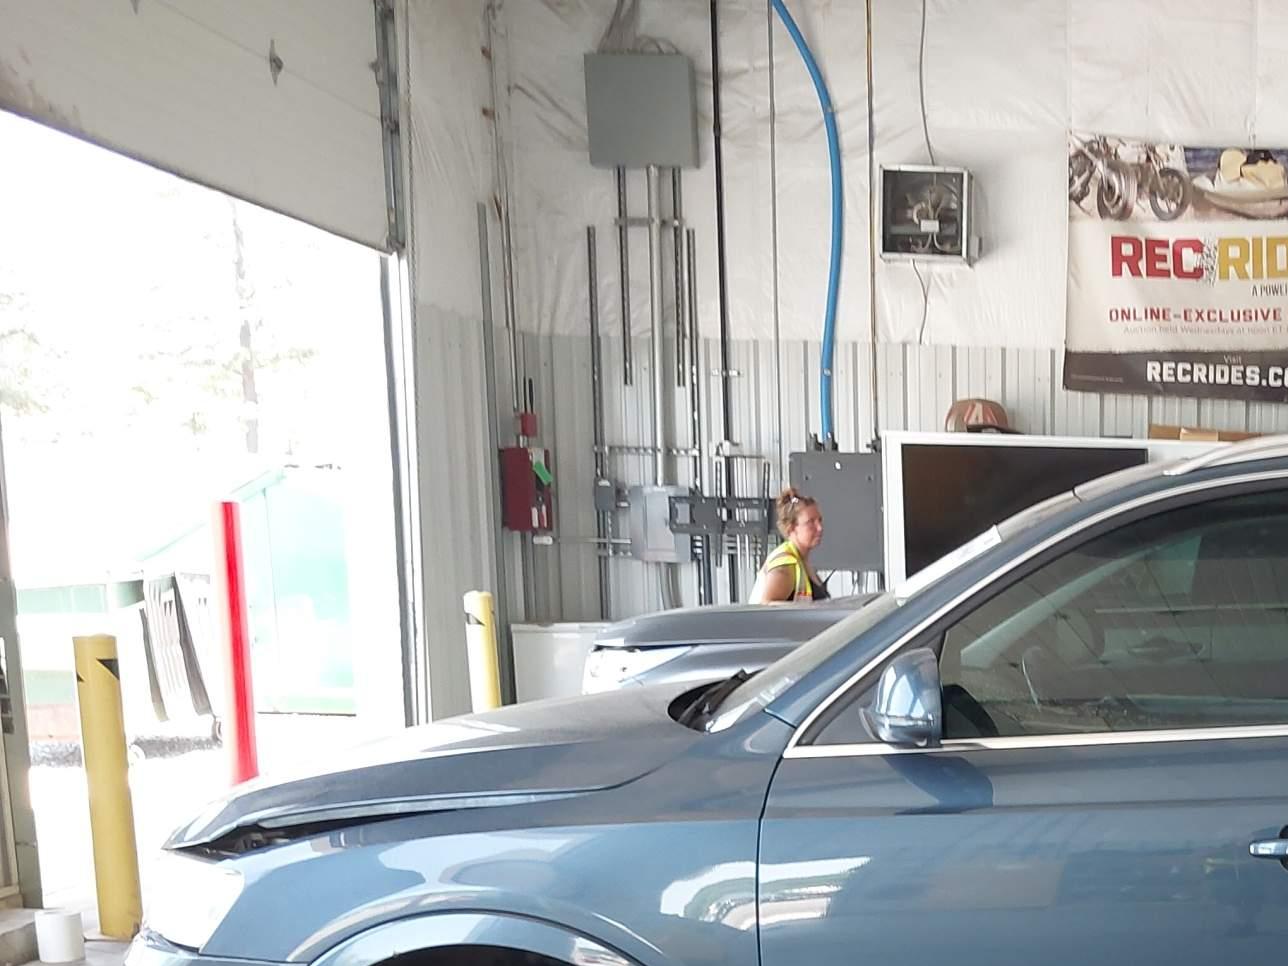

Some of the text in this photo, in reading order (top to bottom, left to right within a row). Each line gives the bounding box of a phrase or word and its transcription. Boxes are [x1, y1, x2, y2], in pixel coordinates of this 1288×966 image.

[1111, 236, 1204, 279] REC
[1251, 284, 1258, 297] A
[1109, 306, 1282, 322] ONLINE-EXCLUSIVE
